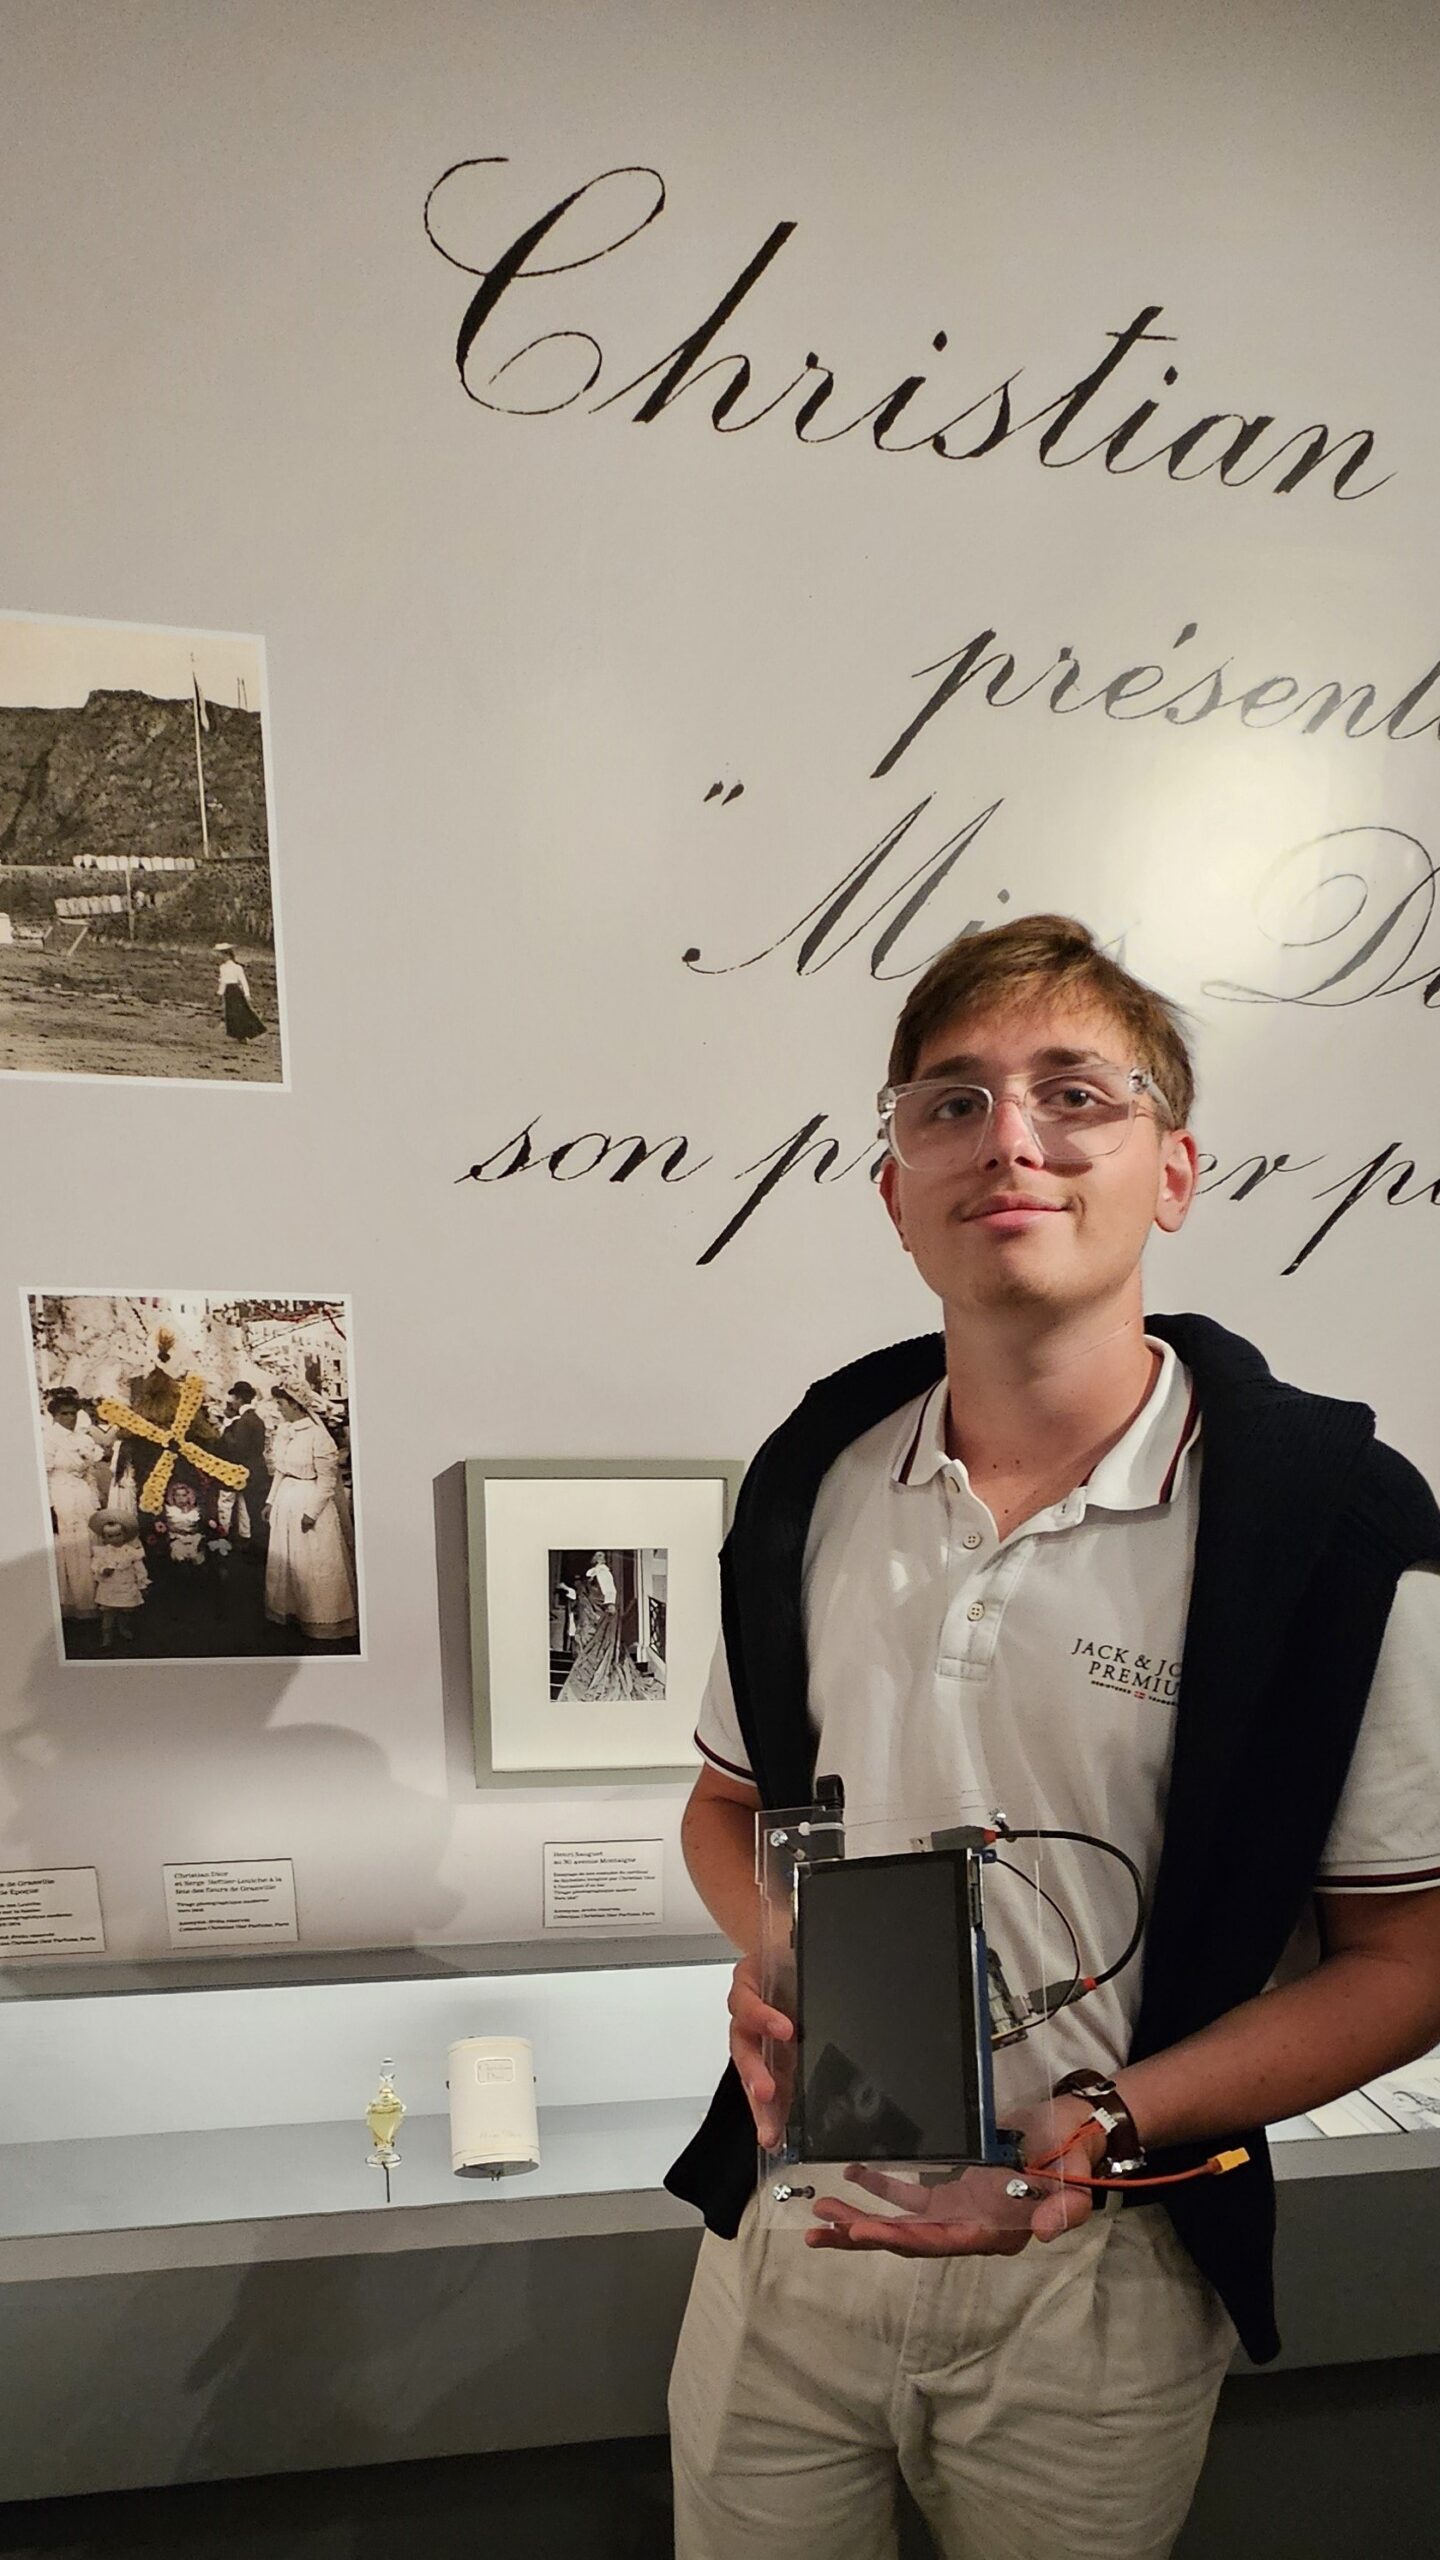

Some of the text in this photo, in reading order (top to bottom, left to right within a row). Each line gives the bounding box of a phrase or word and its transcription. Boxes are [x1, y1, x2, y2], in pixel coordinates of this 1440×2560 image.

[424, 157, 1397, 501] Christian
[453, 1113, 713, 1183] son
[1071, 1638, 1130, 1664] JACK
[1134, 1654, 1152, 1670] &
[1087, 1660, 1181, 1697] PREMIU
[174, 1871, 209, 1879] Christian
